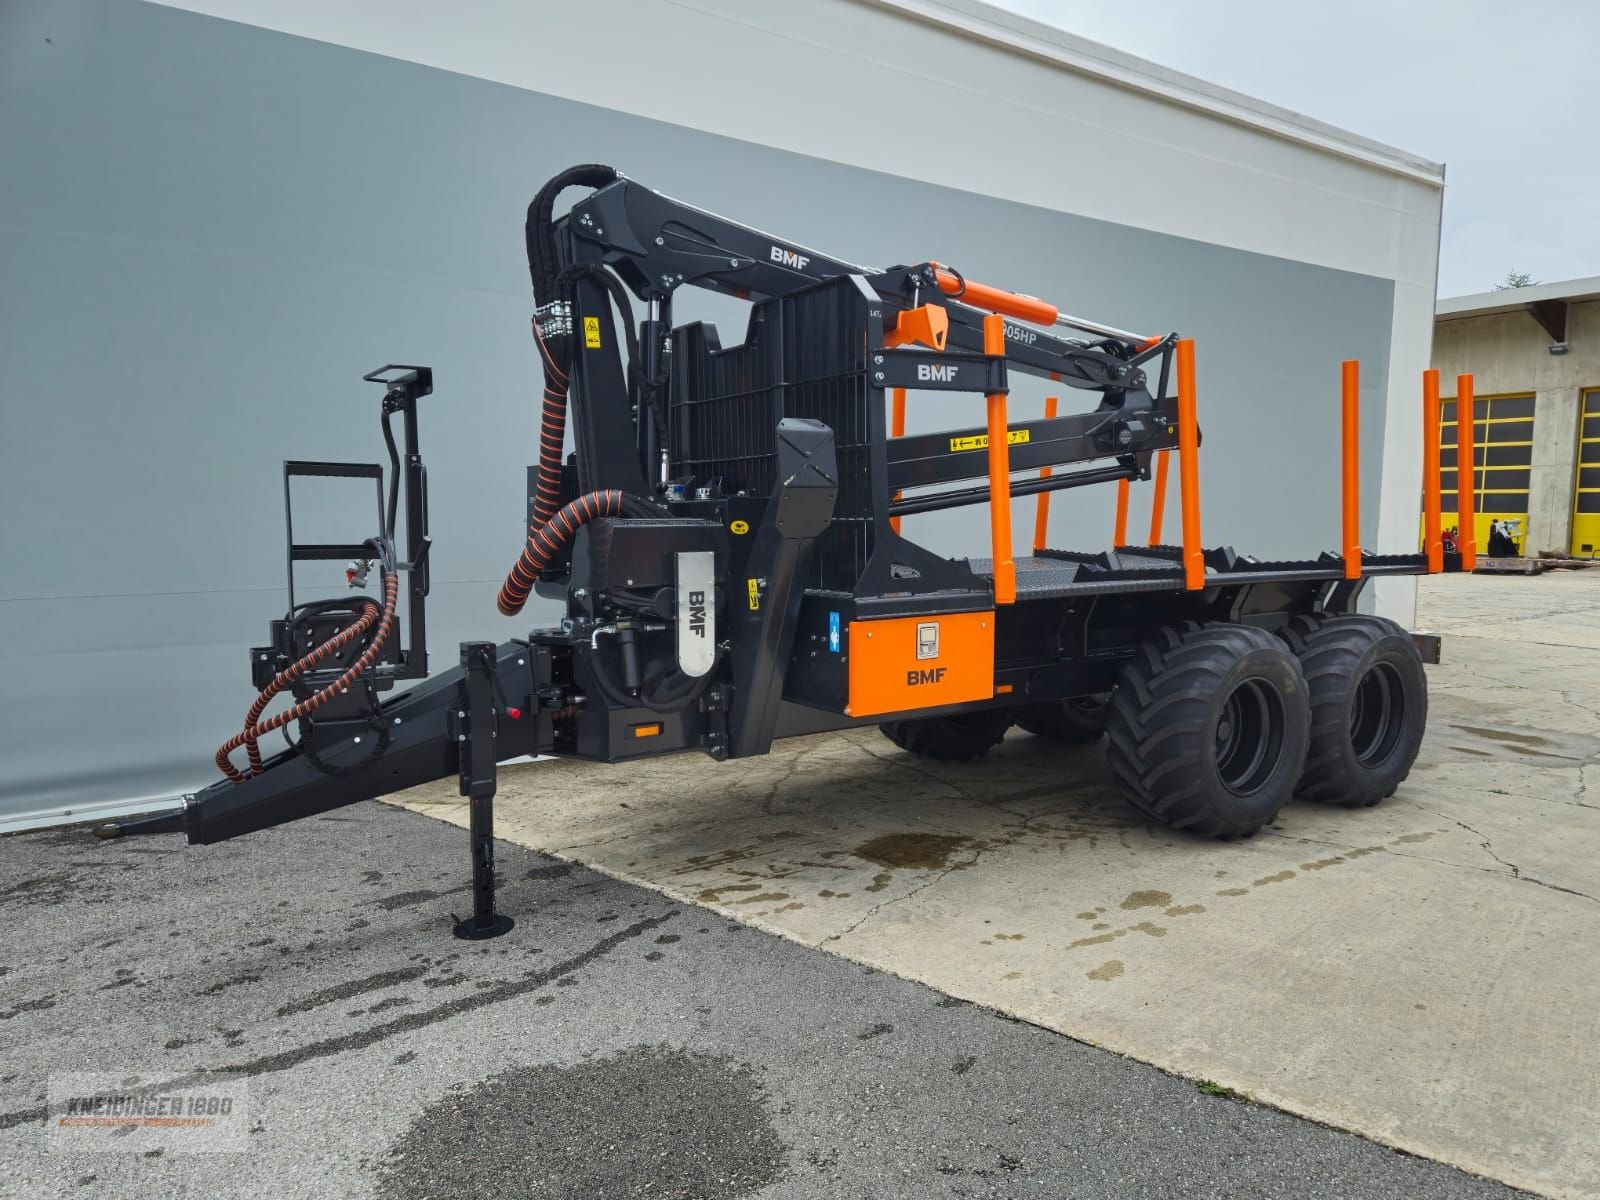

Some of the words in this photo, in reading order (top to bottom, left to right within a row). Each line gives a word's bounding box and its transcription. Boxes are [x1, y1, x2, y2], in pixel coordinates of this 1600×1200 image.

[770, 246, 810, 270] BMF
[917, 363, 959, 382] BMF
[689, 591, 706, 638] BMF
[907, 667, 947, 686] BMF
